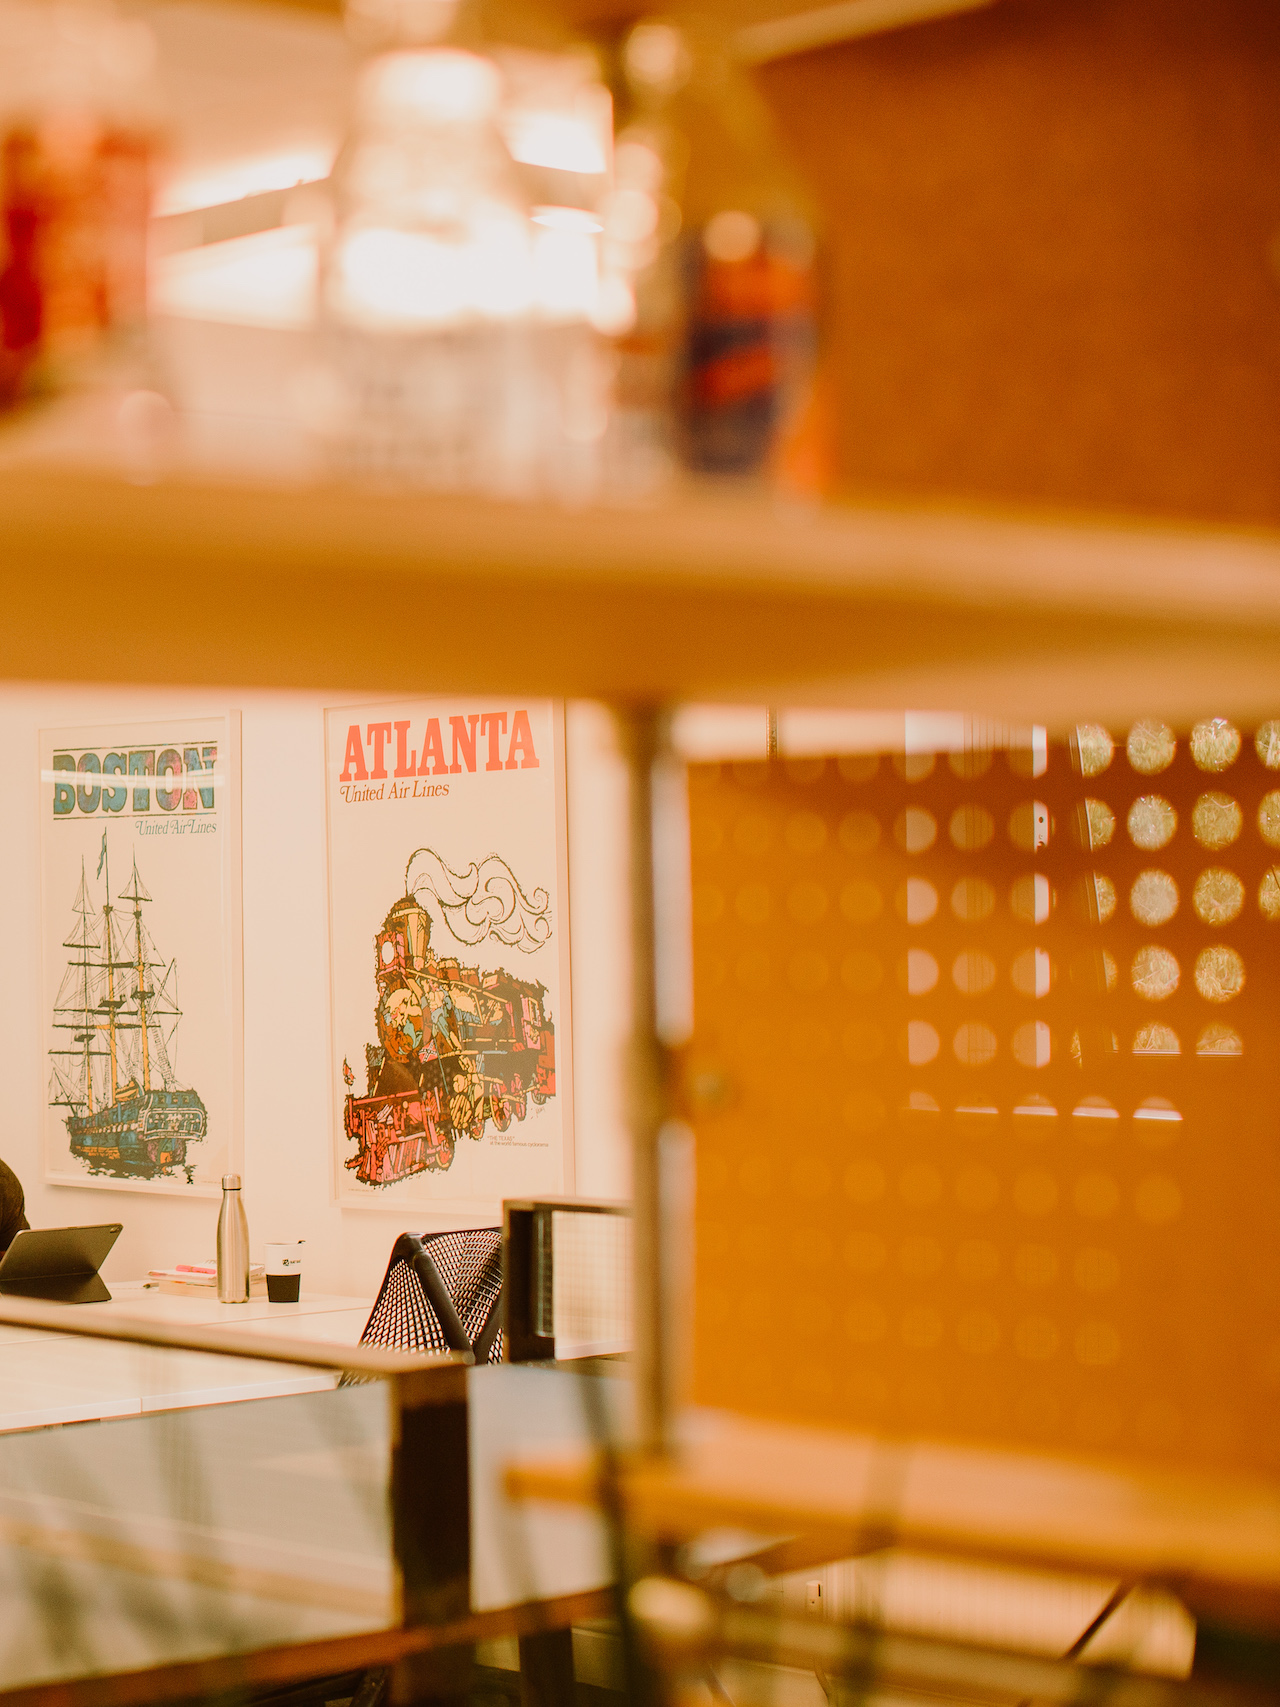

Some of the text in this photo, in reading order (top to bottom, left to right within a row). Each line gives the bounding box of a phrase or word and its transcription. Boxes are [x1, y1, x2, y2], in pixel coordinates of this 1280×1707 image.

[339, 709, 540, 782] ATLANTA
[53, 746, 218, 815] BOSTON
[339, 779, 450, 804] United Air Lines
[135, 818, 217, 836] United Air Lines
